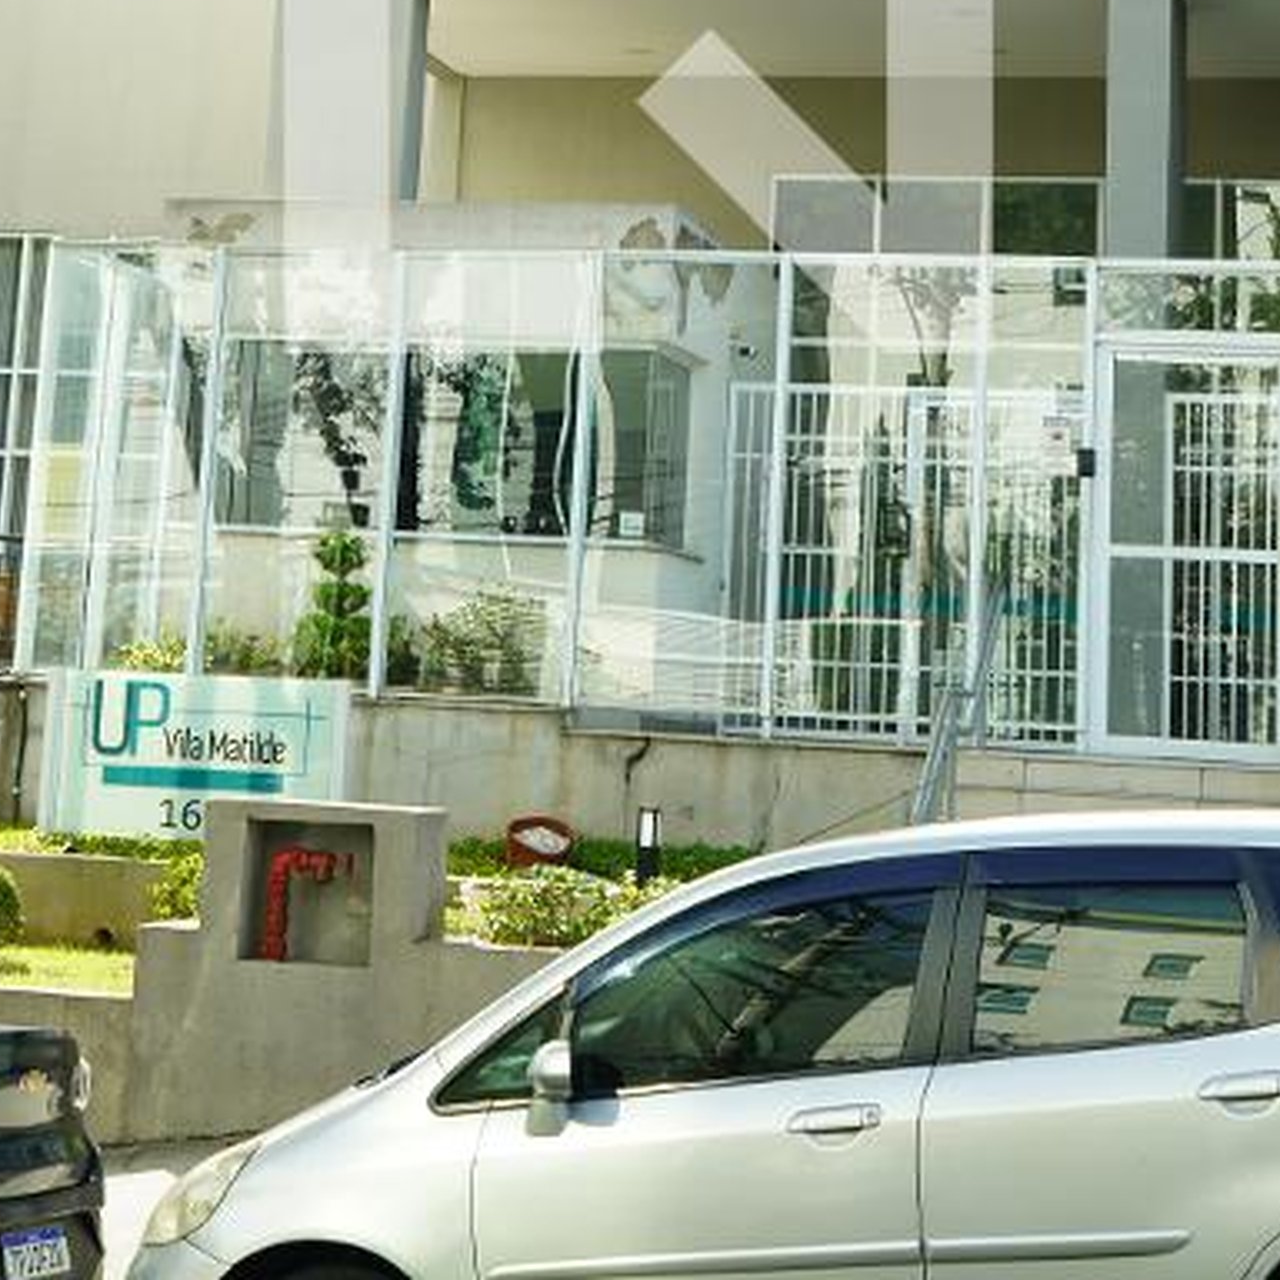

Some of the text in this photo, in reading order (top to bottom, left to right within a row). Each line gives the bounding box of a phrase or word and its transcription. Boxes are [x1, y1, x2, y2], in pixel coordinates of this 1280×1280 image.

[93, 679, 287, 765] UP Vila Matilde
